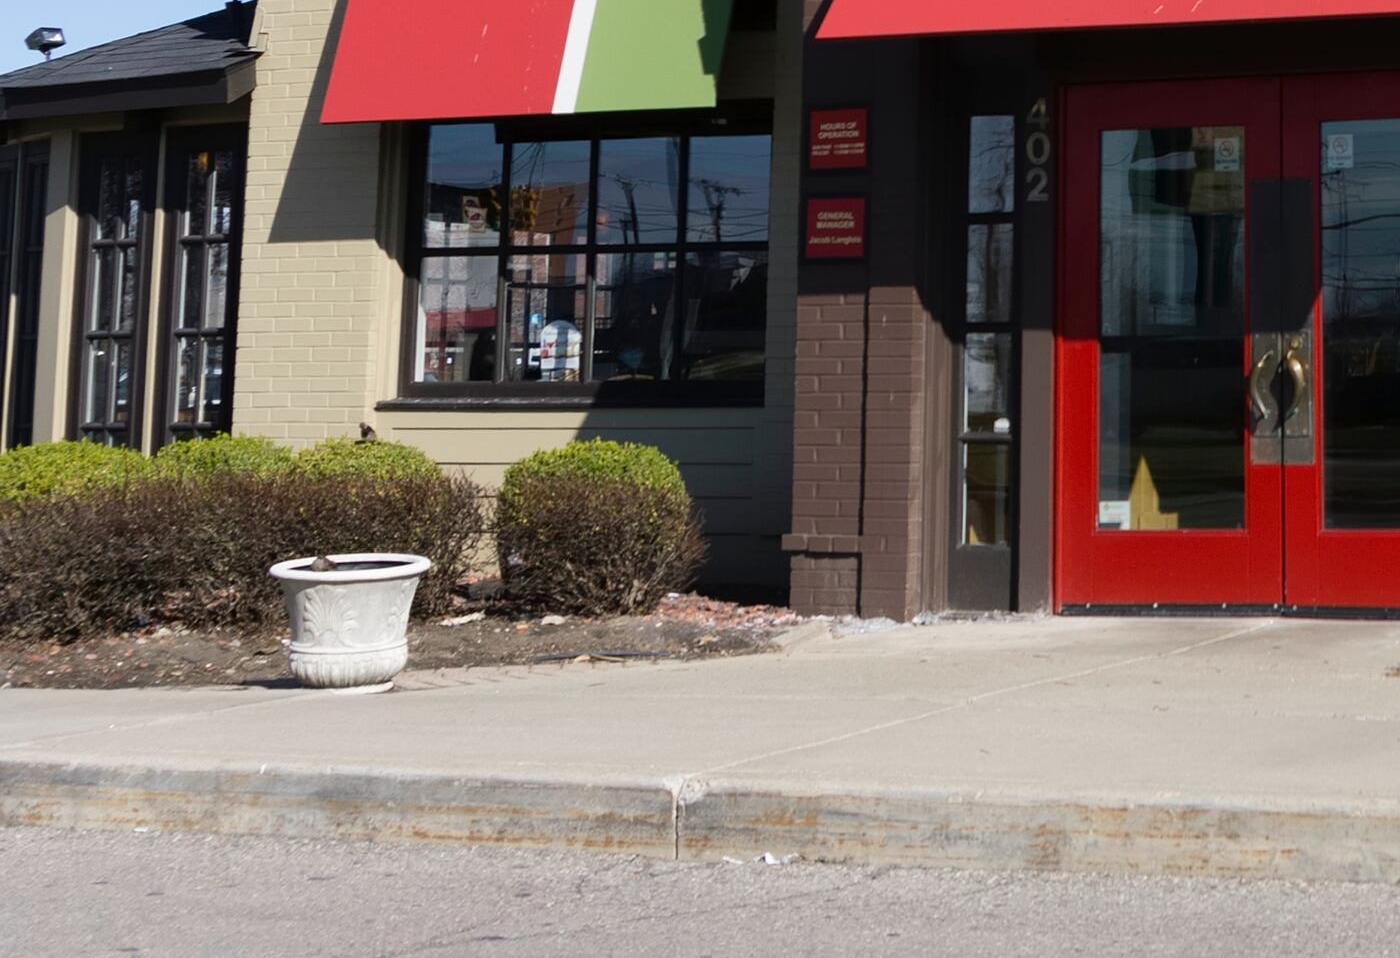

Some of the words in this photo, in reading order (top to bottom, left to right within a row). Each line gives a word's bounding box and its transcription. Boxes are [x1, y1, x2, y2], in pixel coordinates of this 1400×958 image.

[820, 122, 846, 131] HOURS
[847, 121, 857, 130] OF
[817, 130, 860, 140] OPERATION
[1026, 97, 1051, 202] 402
[817, 211, 854, 220] GENERAL
[816, 220, 855, 229] MANAGER
